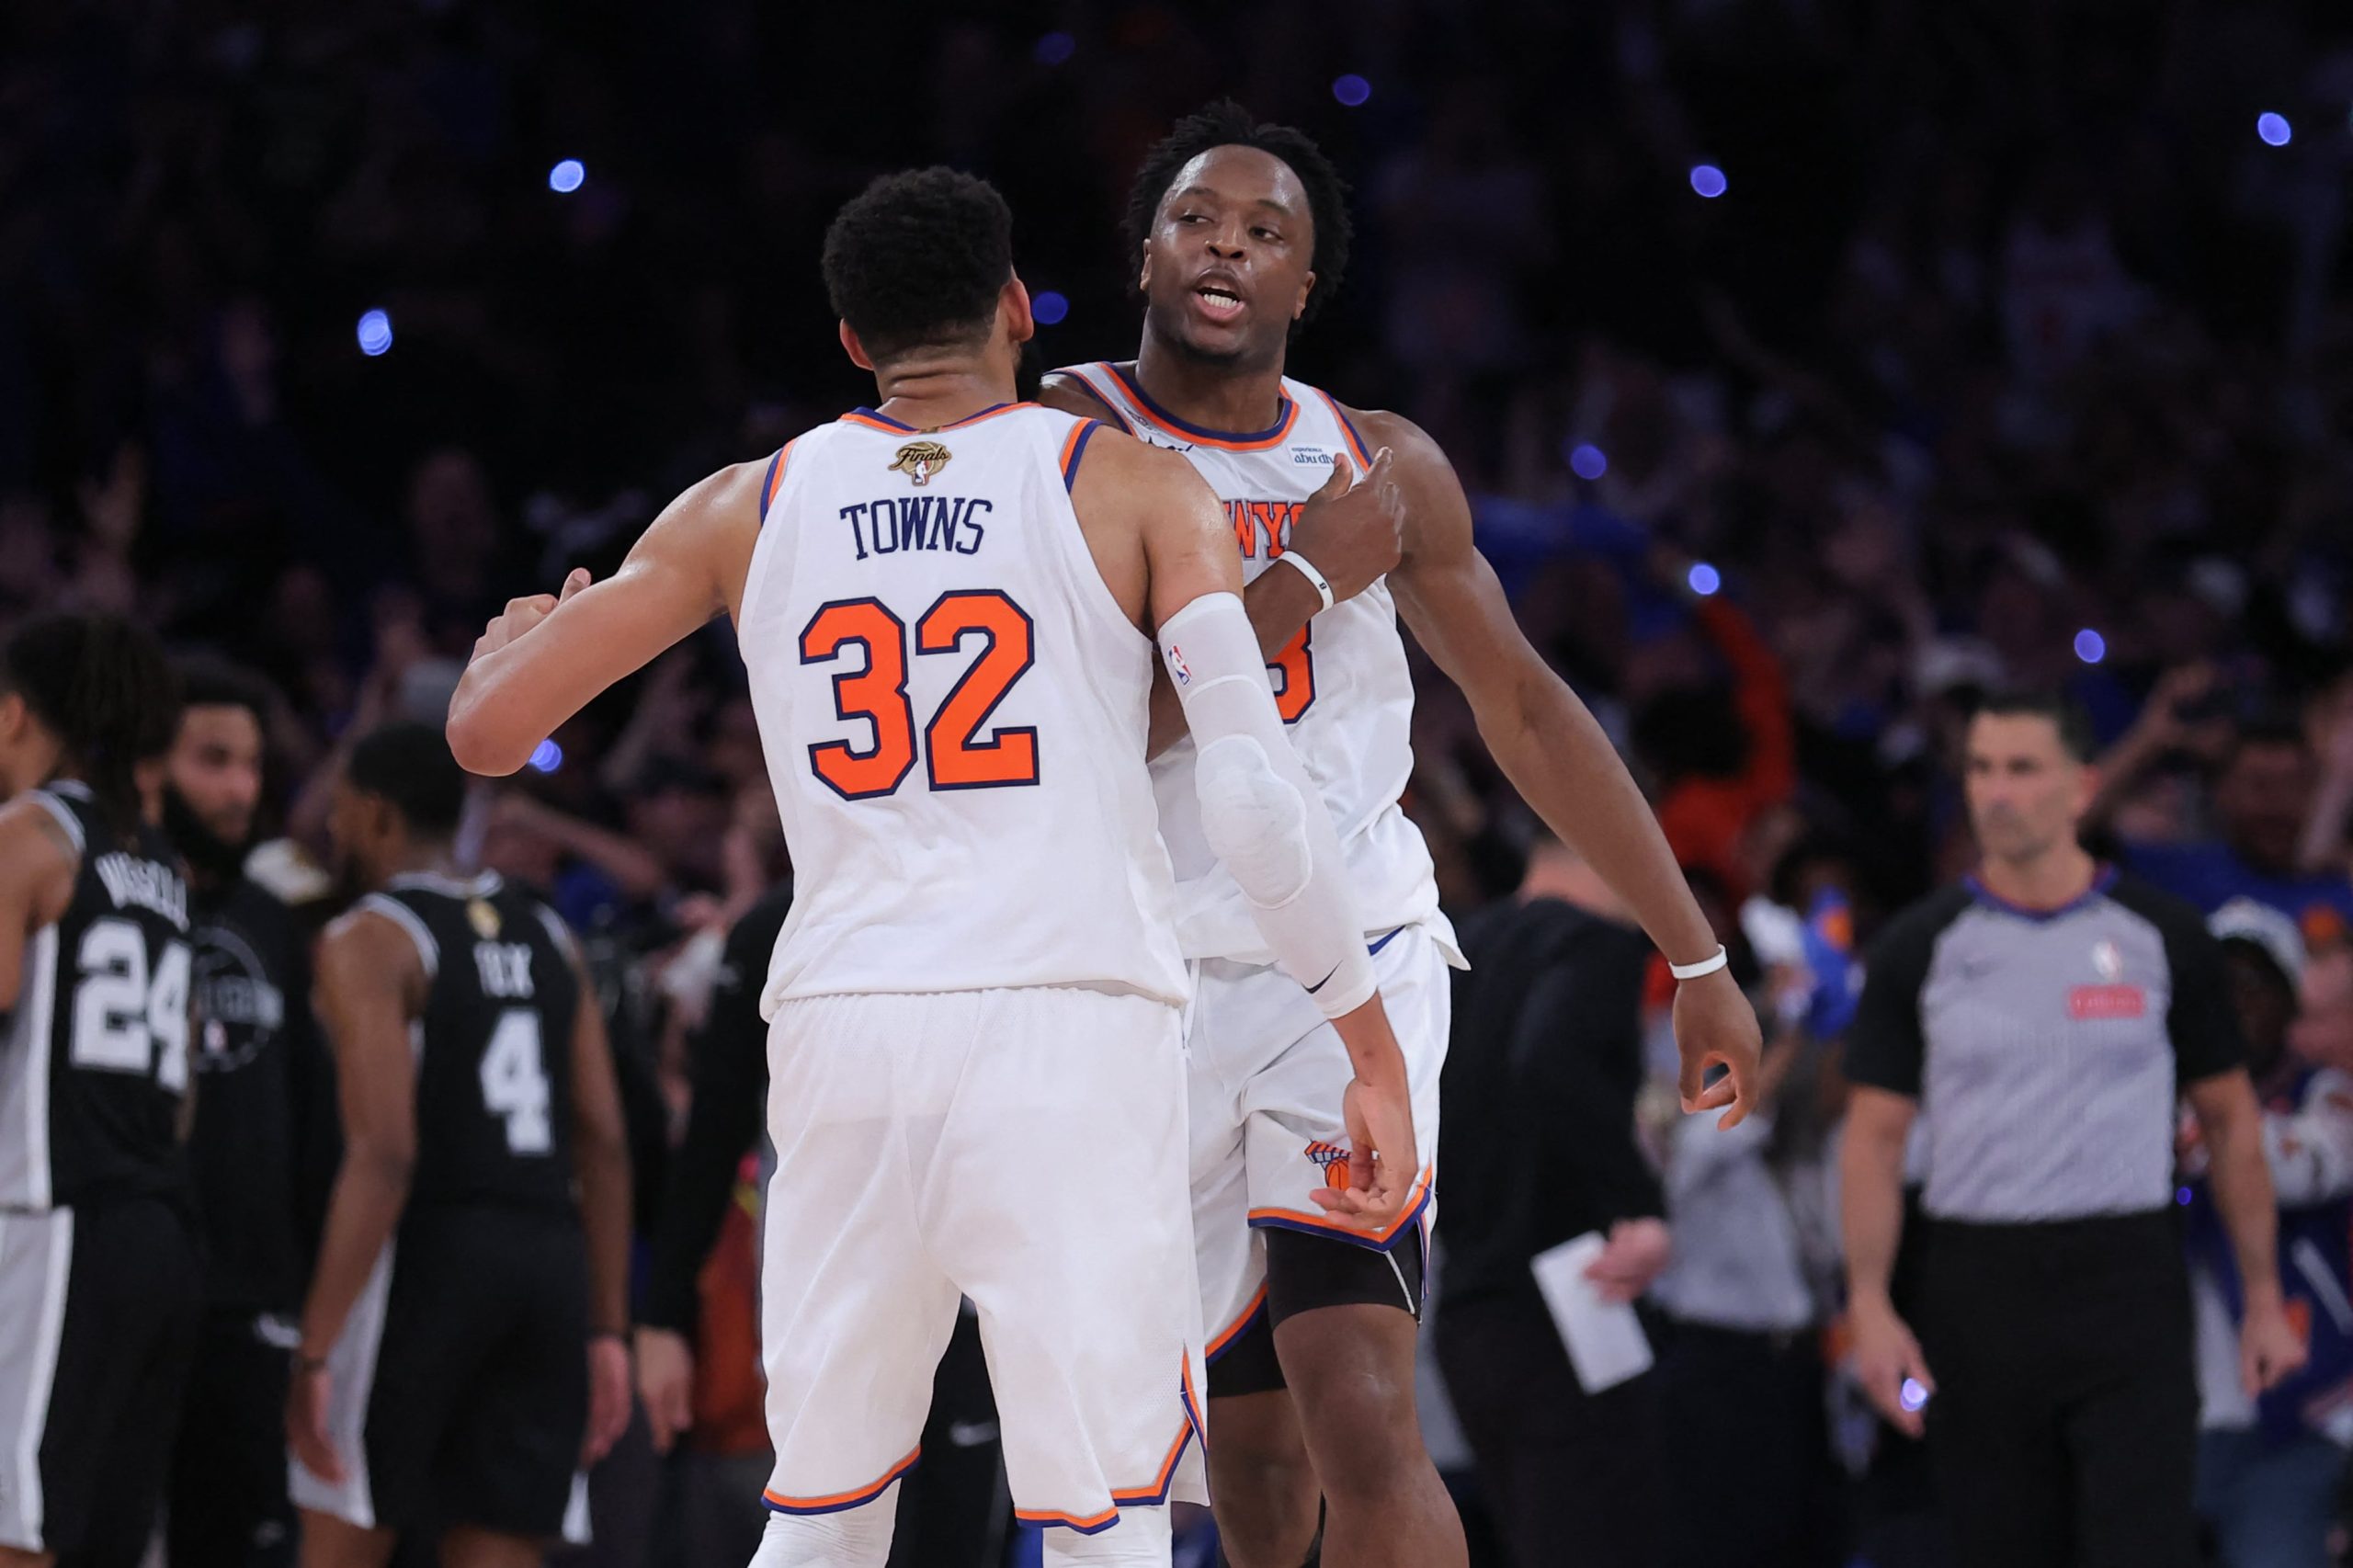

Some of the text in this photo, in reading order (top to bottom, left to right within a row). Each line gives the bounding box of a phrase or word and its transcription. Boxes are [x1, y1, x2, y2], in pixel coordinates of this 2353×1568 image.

[892, 447, 949, 469] Finals
[1294, 453, 1318, 464] abu
[839, 495, 993, 561] TOWNS
[798, 588, 1040, 801] 32
[70, 916, 192, 1091] 24
[479, 1006, 554, 1155] 4
